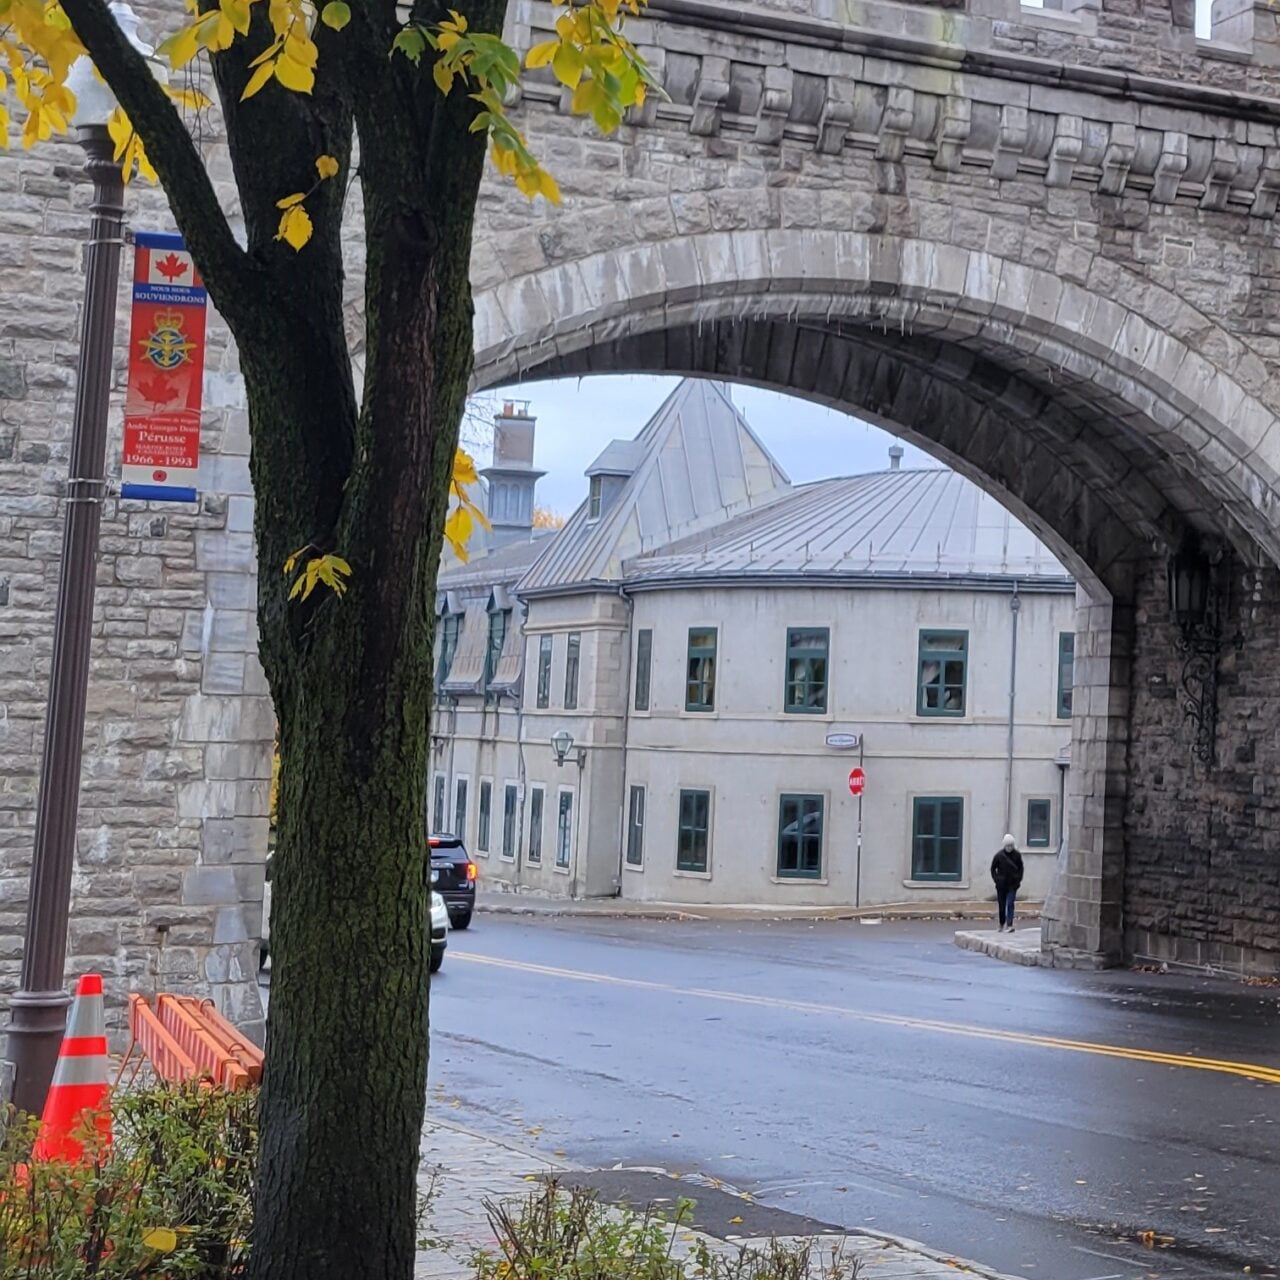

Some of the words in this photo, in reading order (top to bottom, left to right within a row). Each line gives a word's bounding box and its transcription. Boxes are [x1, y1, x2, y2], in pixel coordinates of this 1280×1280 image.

[135, 292, 205, 304] SOUVIENDRONS
[138, 431, 186, 443] Pérusse
[126, 454, 154, 464] 1966
[166, 456, 193, 466] 1993
